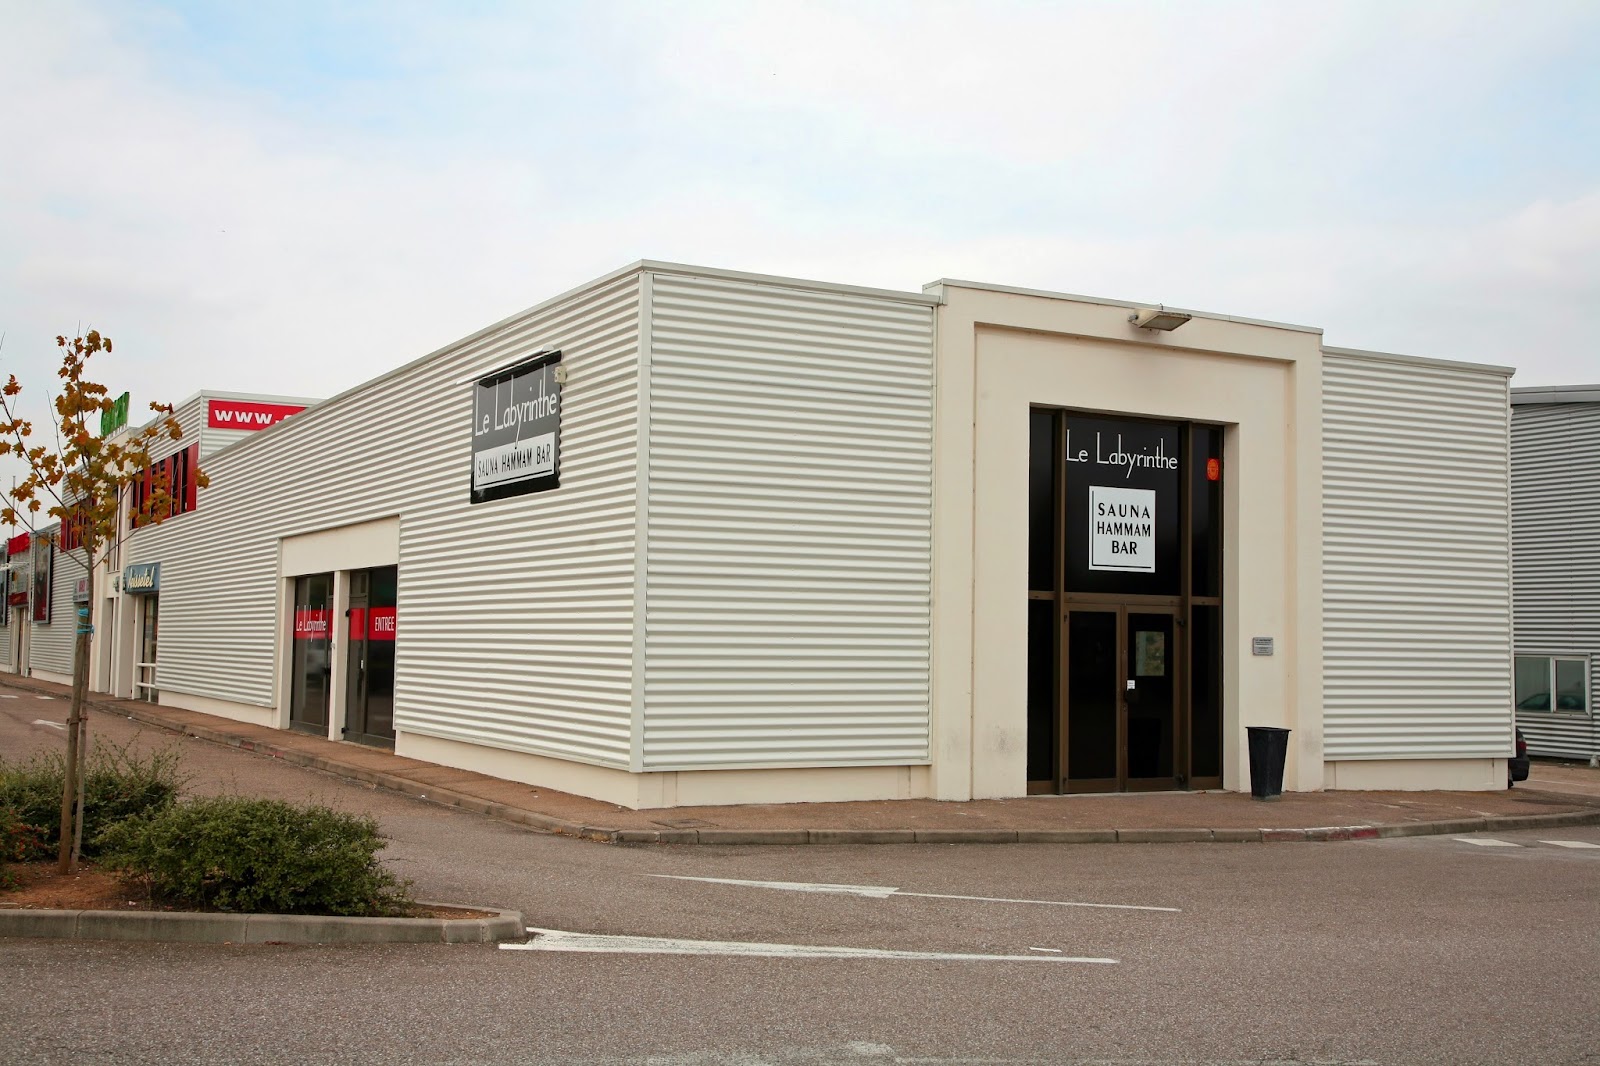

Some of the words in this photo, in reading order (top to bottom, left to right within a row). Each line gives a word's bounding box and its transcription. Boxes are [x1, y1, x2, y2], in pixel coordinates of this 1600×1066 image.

[475, 386, 490, 437] Le
[494, 363, 557, 449] Labyrinthe
[478, 456, 498, 478] SAUNA
[501, 448, 532, 473] HAMMAM
[536, 443, 551, 465] BAR
[1066, 429, 1088, 462] Le
[1096, 431, 1178, 479] Labyrinthe
[1097, 502, 1151, 519] SAUNA
[1097, 521, 1151, 537] HAMMAM
[1111, 540, 1138, 555] BAR
[296, 605, 303, 632] Le
[374, 616, 395, 632] ENTREE
